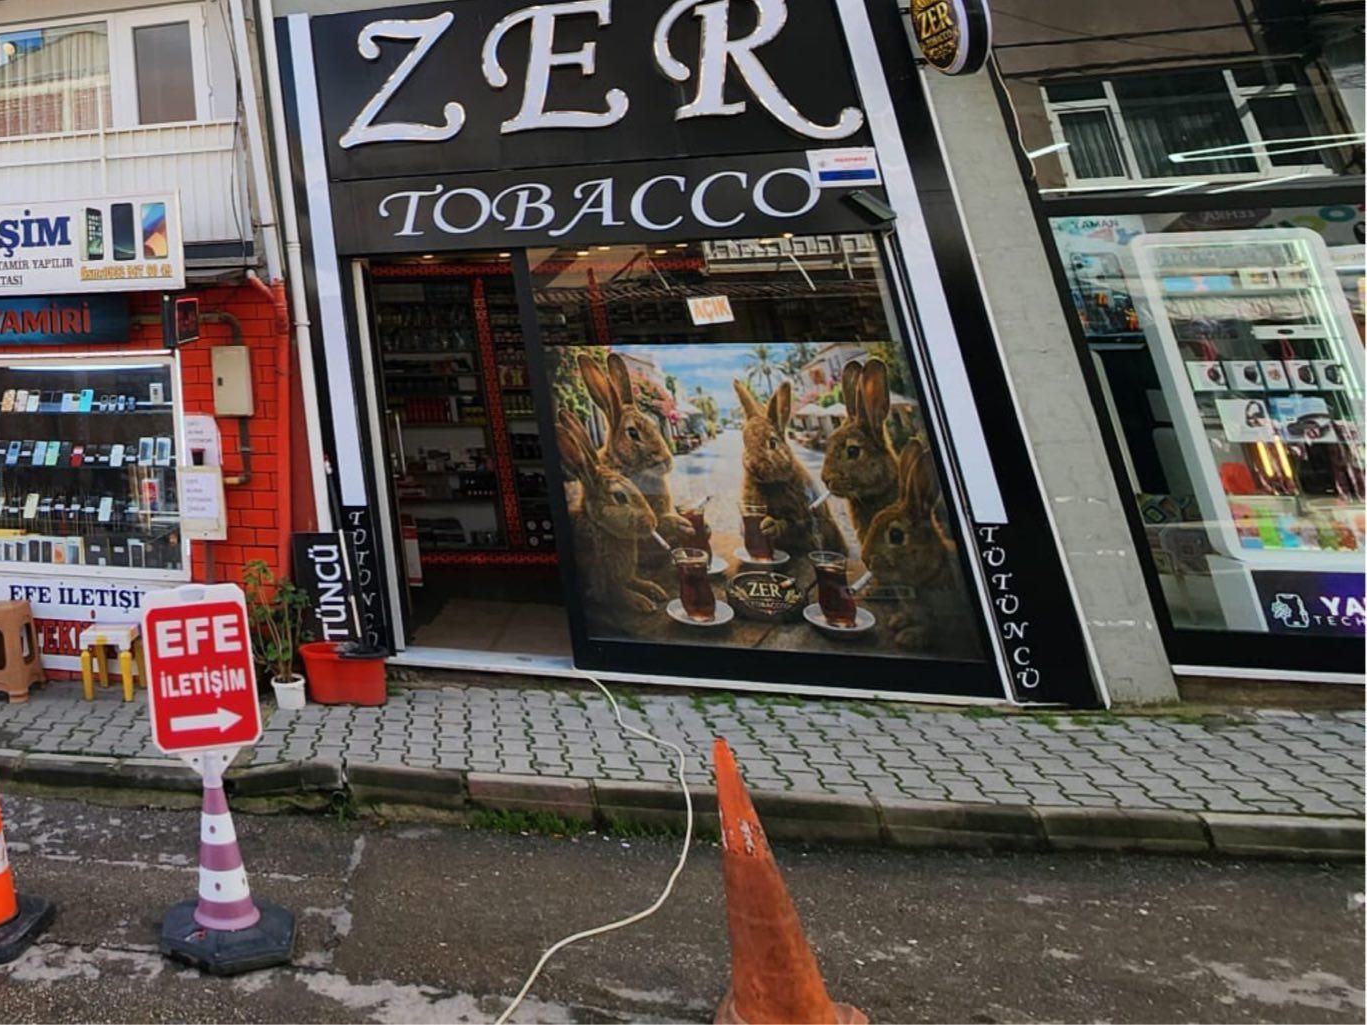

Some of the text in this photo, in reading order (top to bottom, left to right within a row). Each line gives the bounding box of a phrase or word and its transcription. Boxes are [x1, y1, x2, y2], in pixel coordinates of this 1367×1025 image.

[916, 1, 954, 39] ZER
[378, 166, 821, 238] TOBACCO
[9, 581, 146, 614] EFE İLETİŞİ
[307, 544, 349, 642] TÜNCÜ
[747, 581, 782, 598] ZER
[1319, 596, 1366, 617] YA
[155, 614, 243, 658] EFE
[160, 664, 247, 699] İLETİŞİM
